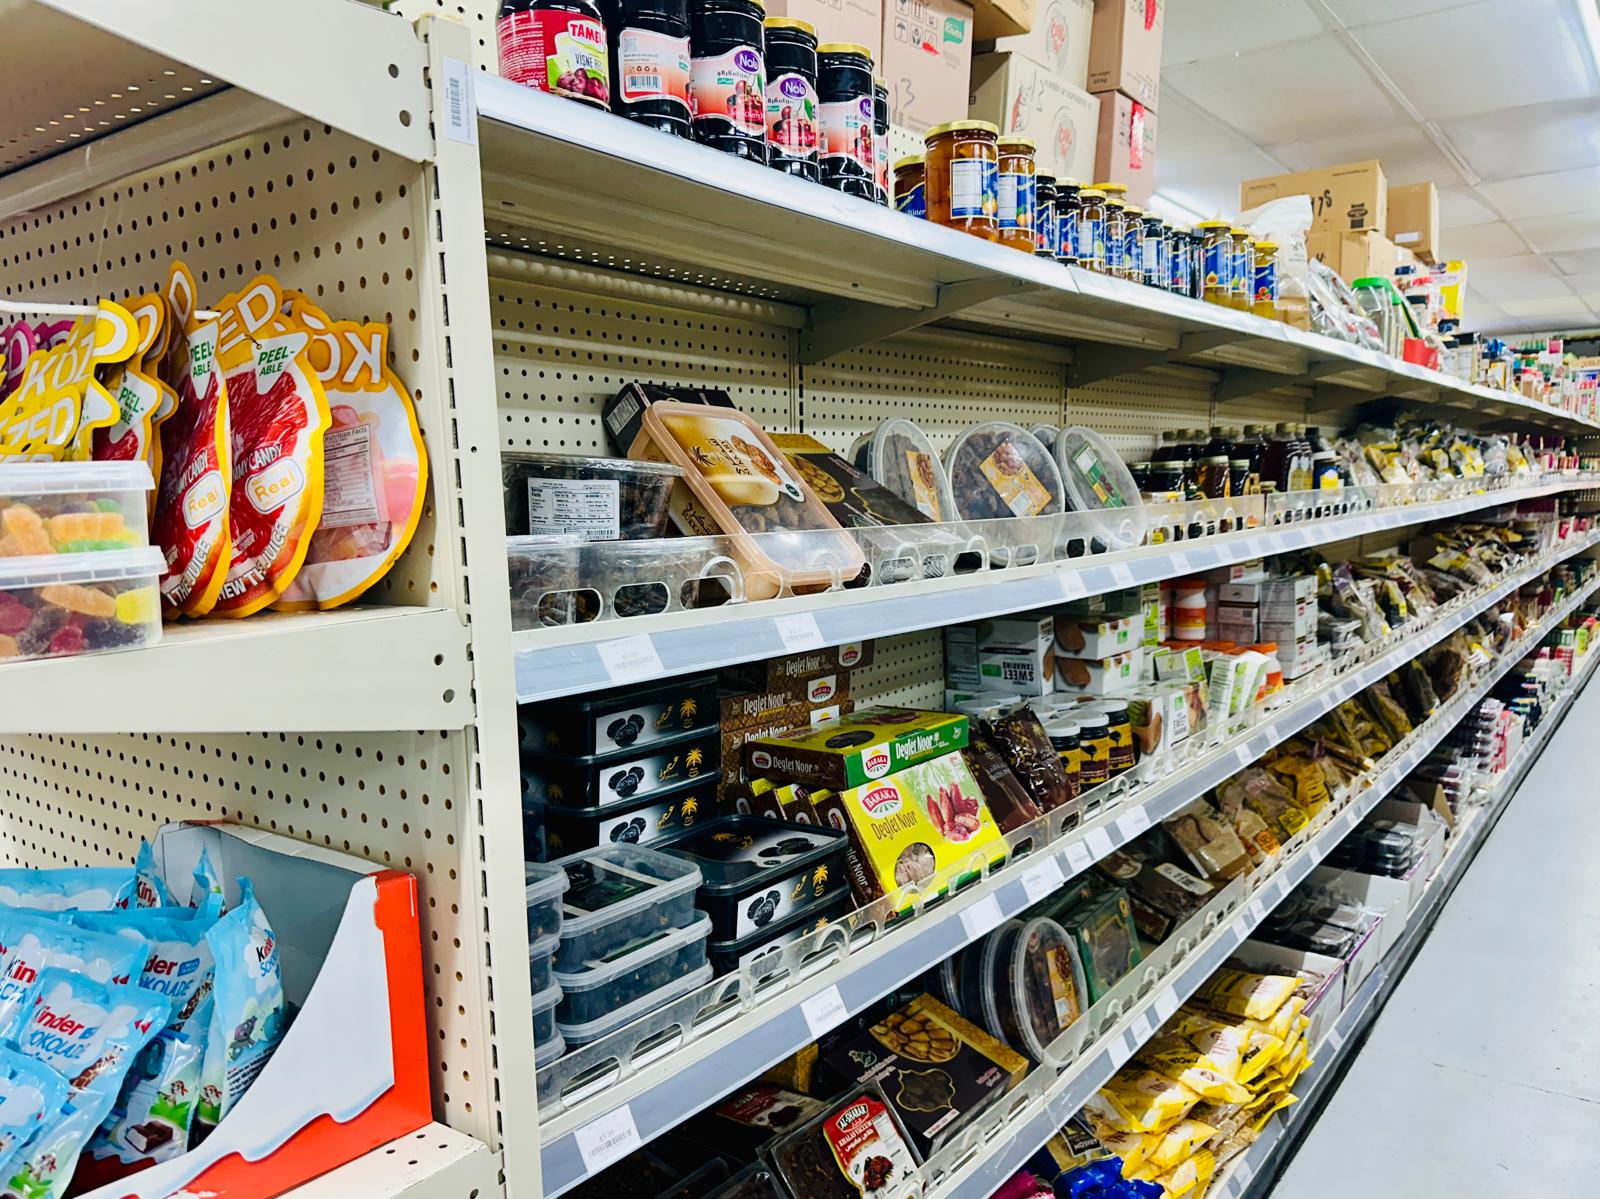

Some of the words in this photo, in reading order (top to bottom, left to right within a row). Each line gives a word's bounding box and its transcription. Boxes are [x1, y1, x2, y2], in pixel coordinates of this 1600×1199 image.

[785, 81, 806, 95] Nab
[258, 346, 294, 365] PEEL-
[192, 361, 211, 378] ABLE
[259, 361, 283, 376] ABLE
[249, 444, 283, 469] CANDY
[254, 469, 295, 501] Real
[188, 485, 219, 514] Real
[264, 524, 290, 568] JUICE
[187, 538, 212, 585] JUICE
[786, 658, 806, 678] Deglet
[806, 656, 820, 672] Noor
[743, 695, 767, 717] Deglet
[768, 693, 785, 709] Noor
[895, 736, 917, 760] Deglet
[917, 734, 933, 752] Noor
[773, 756, 794, 773] Deglet
[795, 759, 813, 774] Noor
[865, 756, 888, 770] BARAKA
[864, 788, 897, 811] BARAKA
[870, 816, 899, 840] Deglet
[897, 811, 918, 831] Noor
[853, 863, 868, 886] Noor
